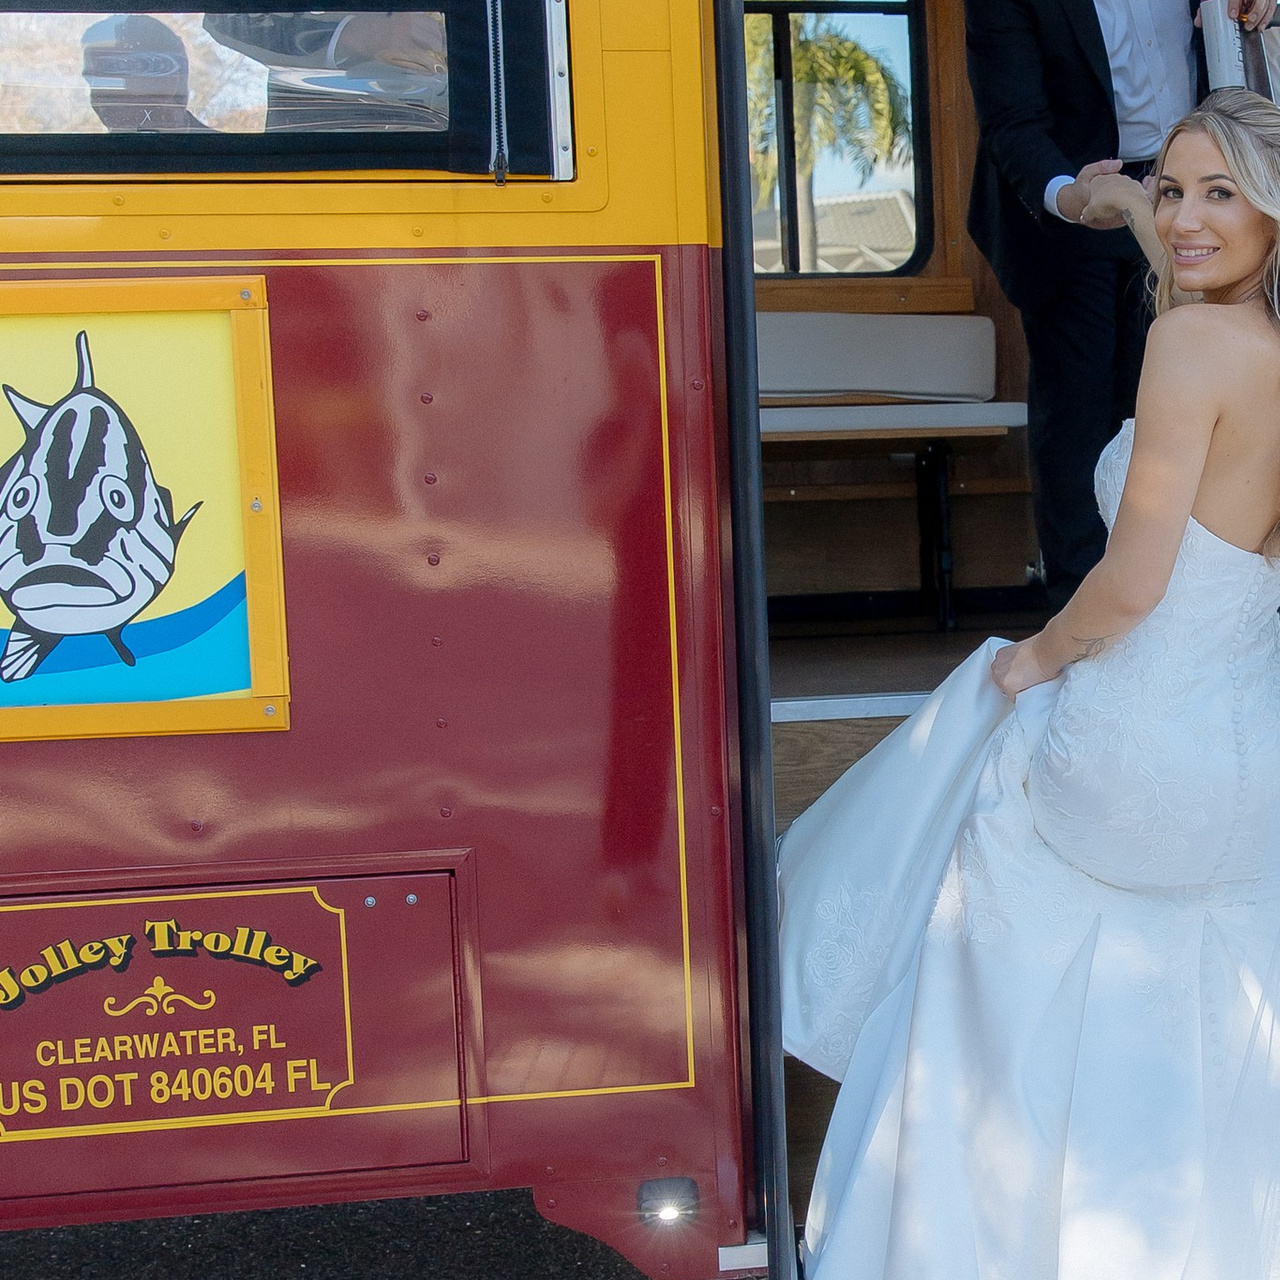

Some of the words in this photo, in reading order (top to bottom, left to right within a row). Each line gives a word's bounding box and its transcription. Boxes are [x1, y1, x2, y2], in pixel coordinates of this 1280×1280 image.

[0, 934, 134, 1007] Jolley
[144, 918, 318, 982] Trolley
[35, 1028, 244, 1067] CLEARWATER,
[252, 1024, 286, 1052] FL
[0, 1080, 48, 1116] US
[60, 1072, 140, 1111] DOT
[149, 1062, 275, 1104] 840604
[286, 1059, 332, 1093] FL
